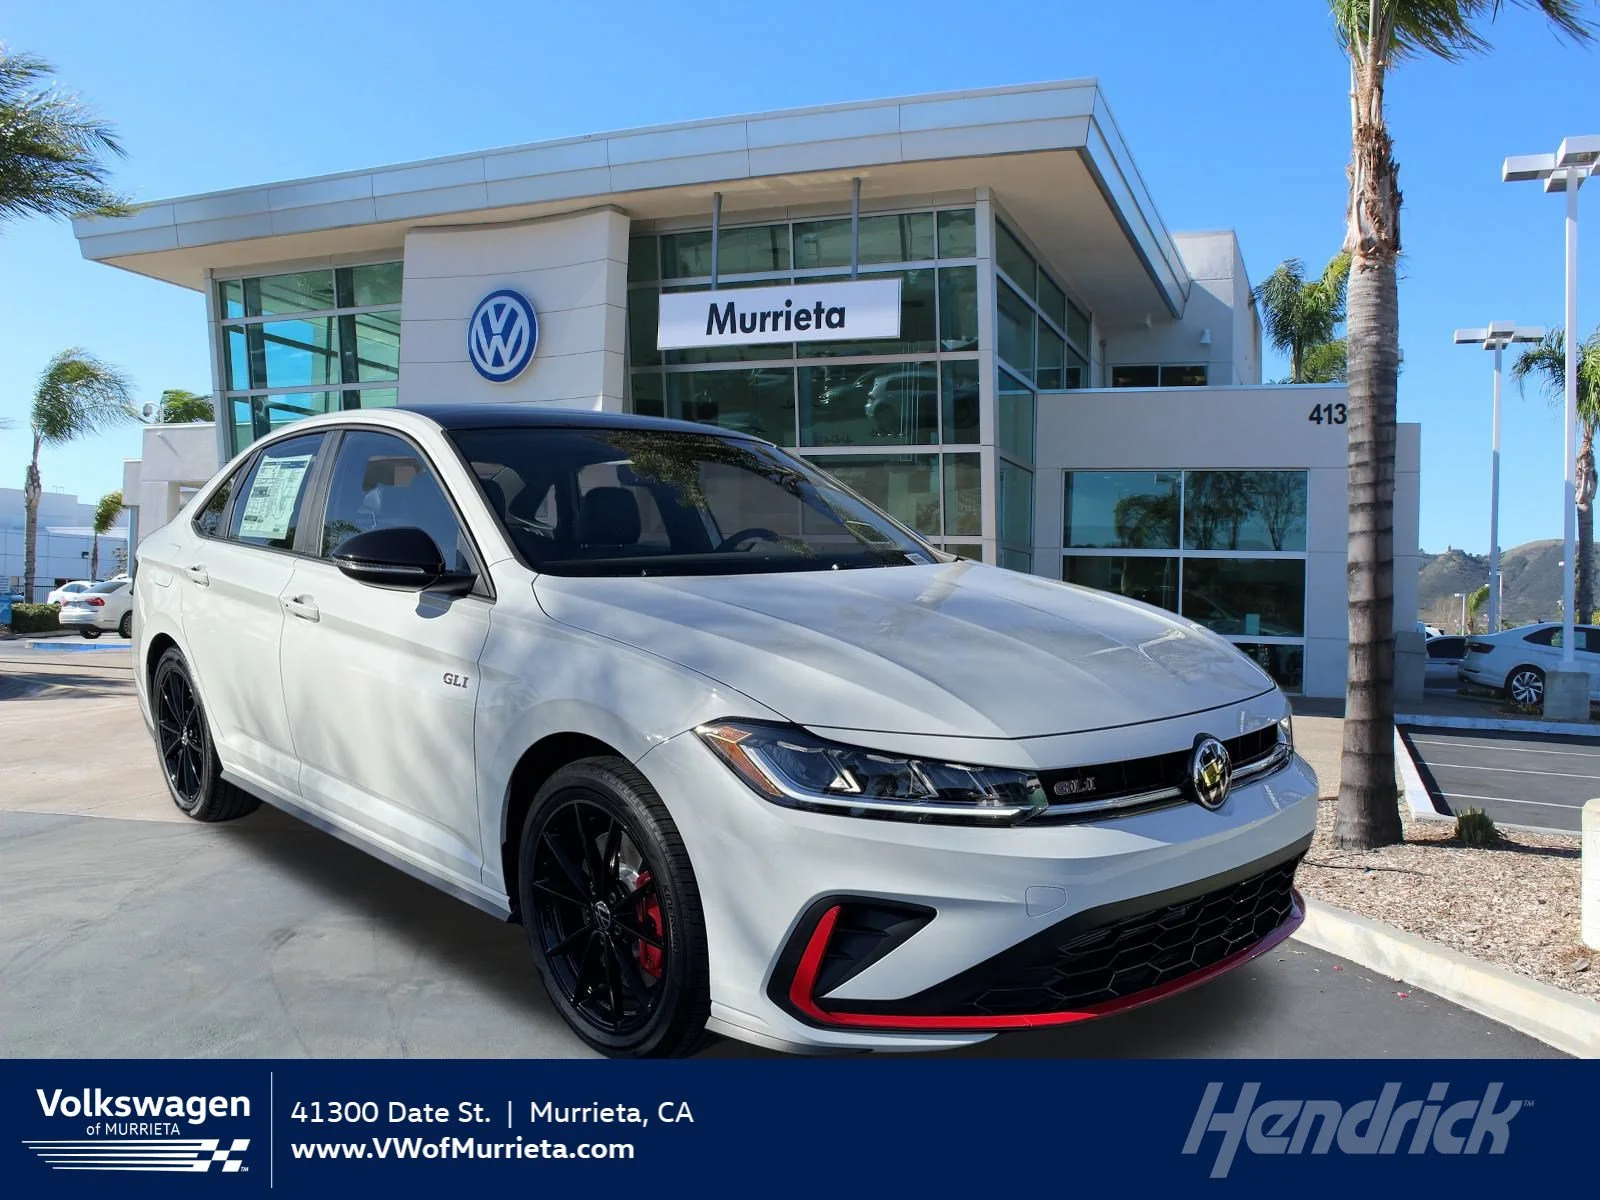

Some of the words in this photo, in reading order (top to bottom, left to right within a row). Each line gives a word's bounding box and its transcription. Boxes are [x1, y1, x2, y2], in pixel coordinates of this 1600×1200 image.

[705, 299, 846, 336] Murrieta
[472, 294, 534, 377] VW
[1308, 403, 1347, 425] 413
[443, 672, 470, 689] GLI
[1053, 776, 1096, 796] GLI
